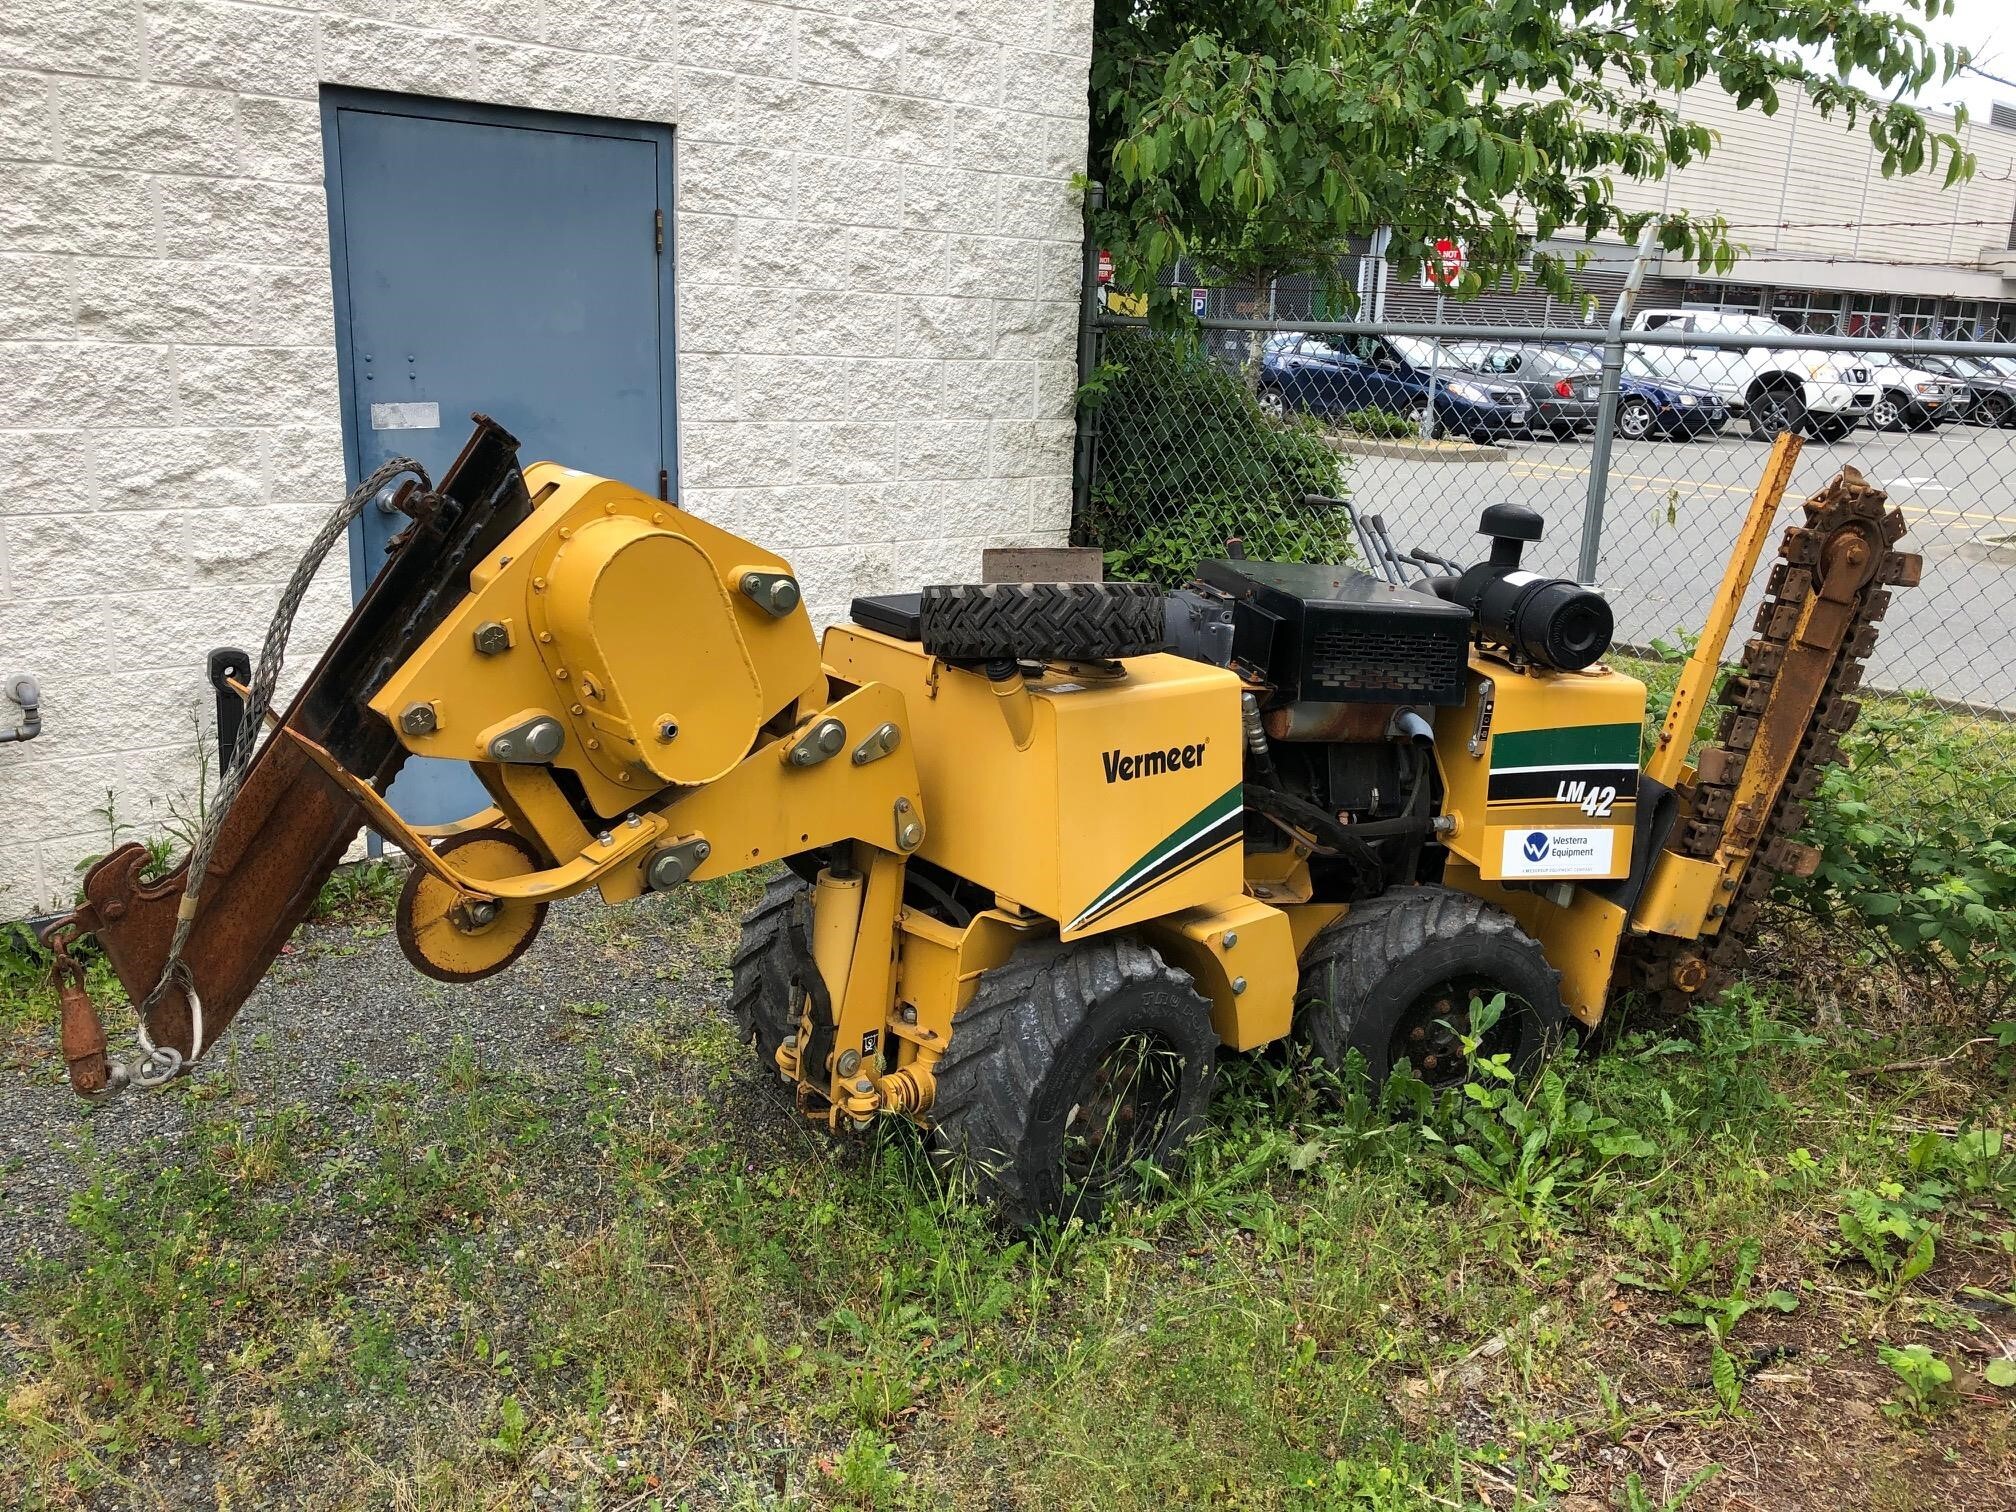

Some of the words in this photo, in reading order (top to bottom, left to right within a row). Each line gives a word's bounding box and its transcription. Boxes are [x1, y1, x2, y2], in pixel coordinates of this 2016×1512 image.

[1443, 250, 1459, 259] NOT
[1195, 299, 1204, 314] P
[1102, 743, 1205, 784] Vermeer
[1552, 836, 1588, 845] Westerra
[1551, 848, 1594, 858] Equipment
